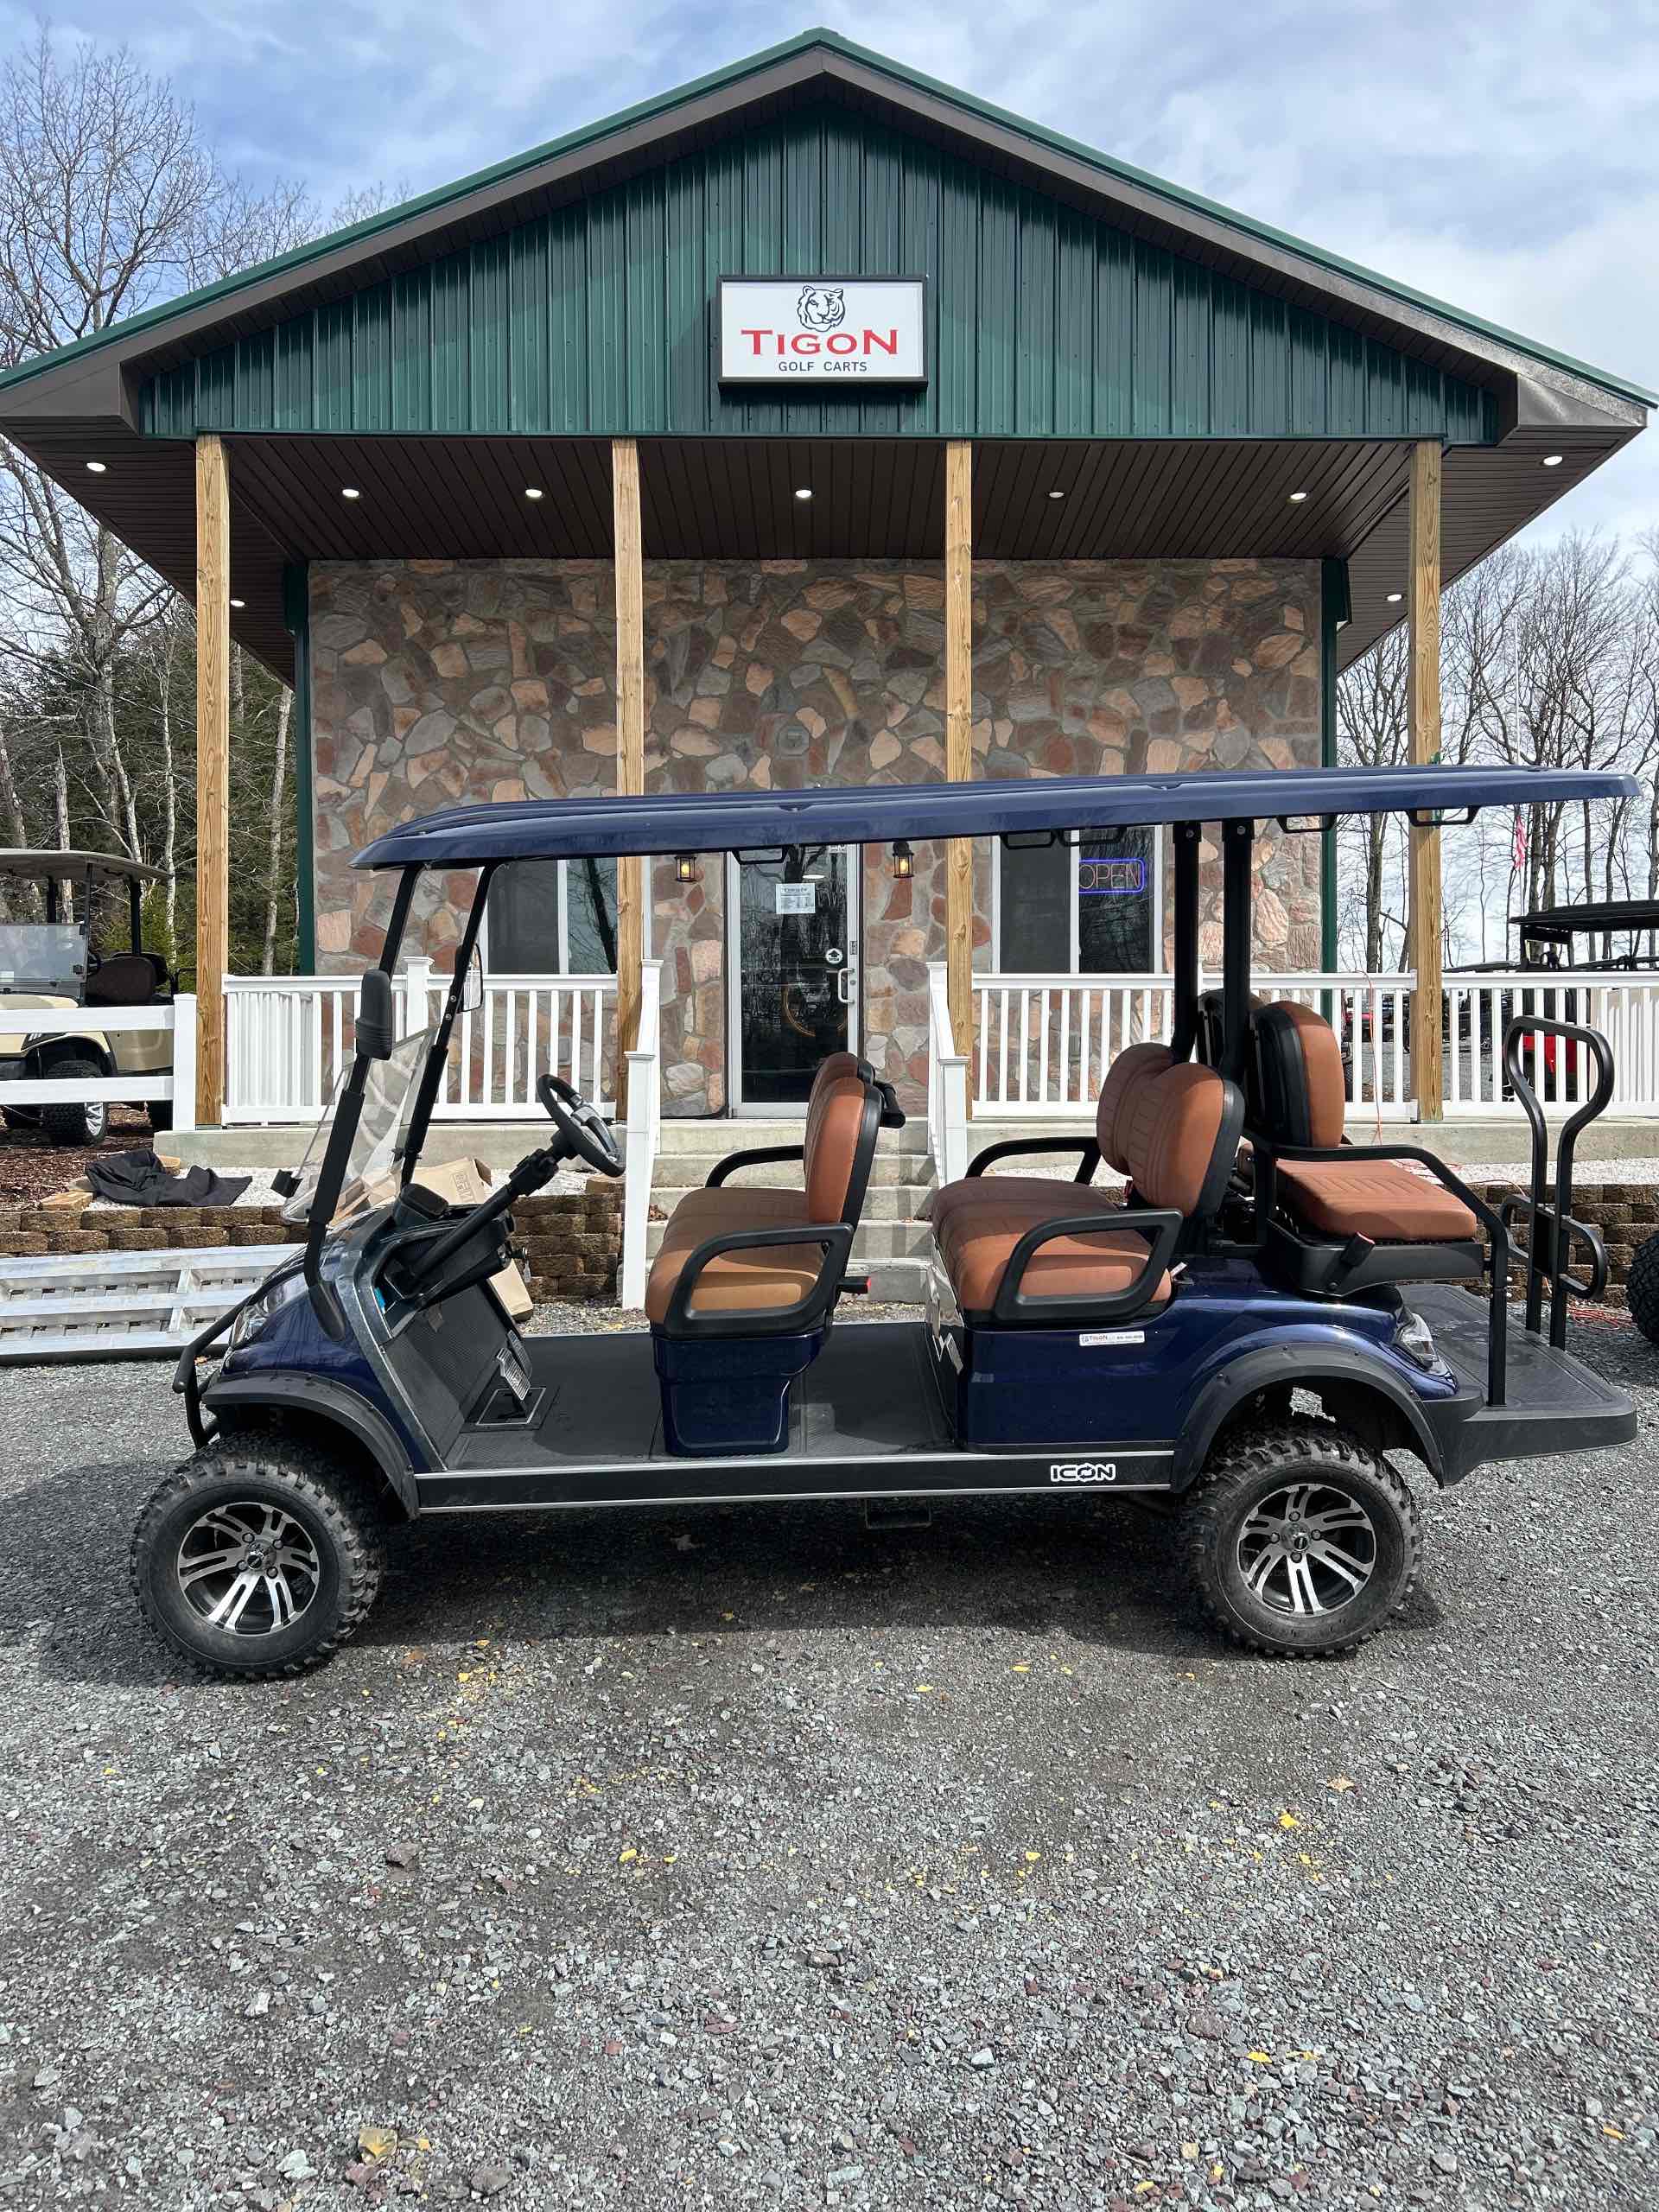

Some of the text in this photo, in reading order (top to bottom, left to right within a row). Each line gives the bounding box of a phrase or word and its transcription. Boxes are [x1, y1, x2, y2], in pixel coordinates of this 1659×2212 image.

[741, 328, 899, 355] TIGON
[779, 361, 868, 372] GOLF CARTS
[1079, 863, 1141, 889] OPEN
[1050, 1462, 1116, 1483] ICON
